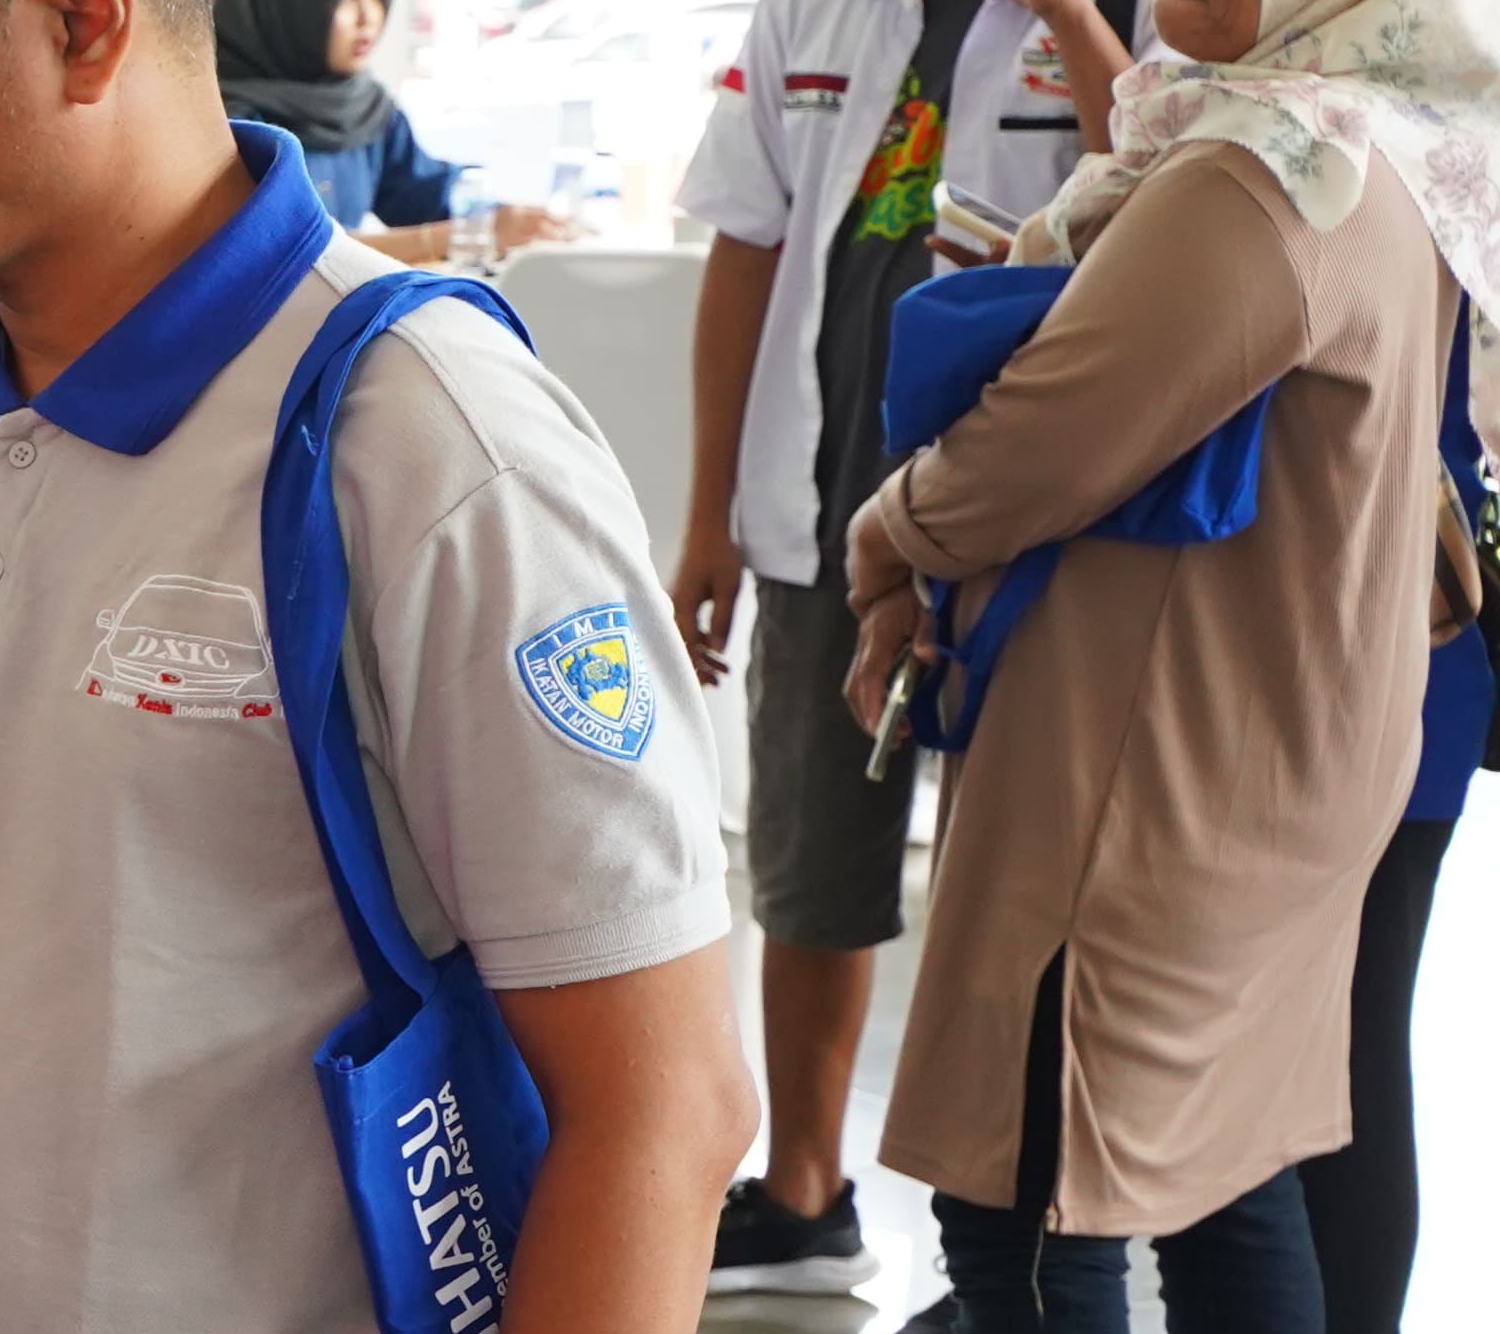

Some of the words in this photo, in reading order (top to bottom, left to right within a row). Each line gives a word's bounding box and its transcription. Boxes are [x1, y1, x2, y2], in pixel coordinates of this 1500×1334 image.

[127, 634, 230, 669] DXIC
[529, 657, 572, 713] IKATAN
[568, 711, 625, 748] MOTOR
[438, 1080, 474, 1176] ASTRA
[473, 1217, 509, 1307] ember
